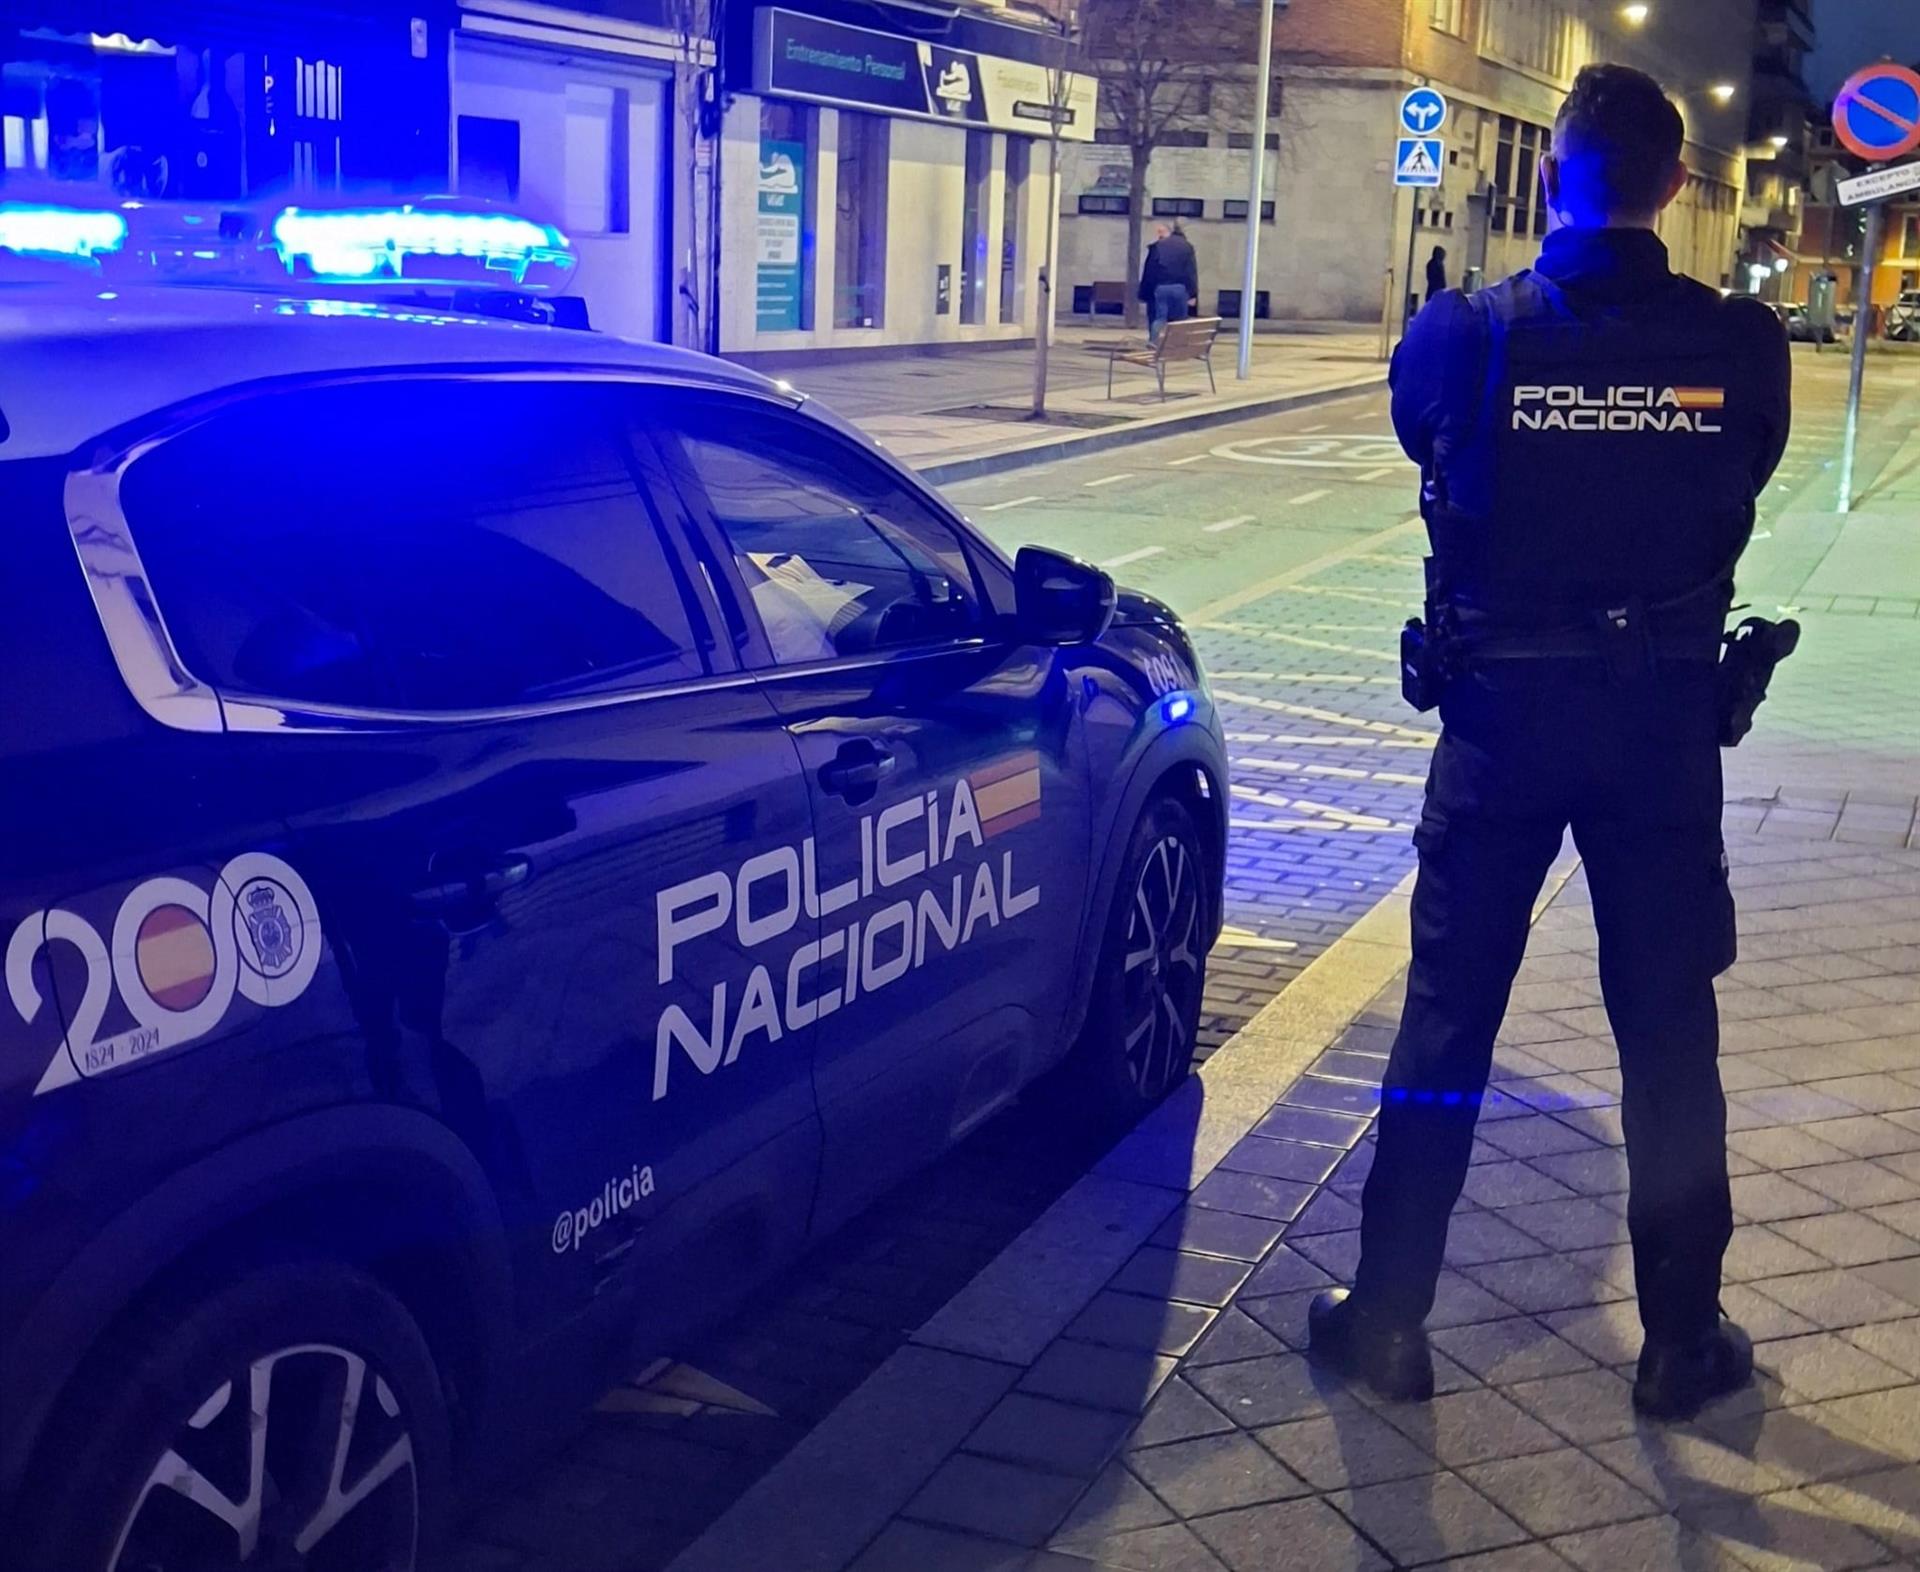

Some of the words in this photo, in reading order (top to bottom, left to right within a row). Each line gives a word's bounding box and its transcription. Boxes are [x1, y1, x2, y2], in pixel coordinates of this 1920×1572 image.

[786, 38, 861, 73] Entrenamiento
[865, 54, 906, 81] Personal
[1856, 169, 1909, 187] EXCEPTO
[1513, 386, 1681, 408] POLICIA
[1512, 409, 1722, 433] NACIONAL
[5, 852, 322, 1097] 200
[652, 850, 1040, 1101] NACIONAL
[85, 1043, 114, 1072] 1824
[130, 1027, 159, 1055] 2024
[552, 1164, 655, 1254] @policia
